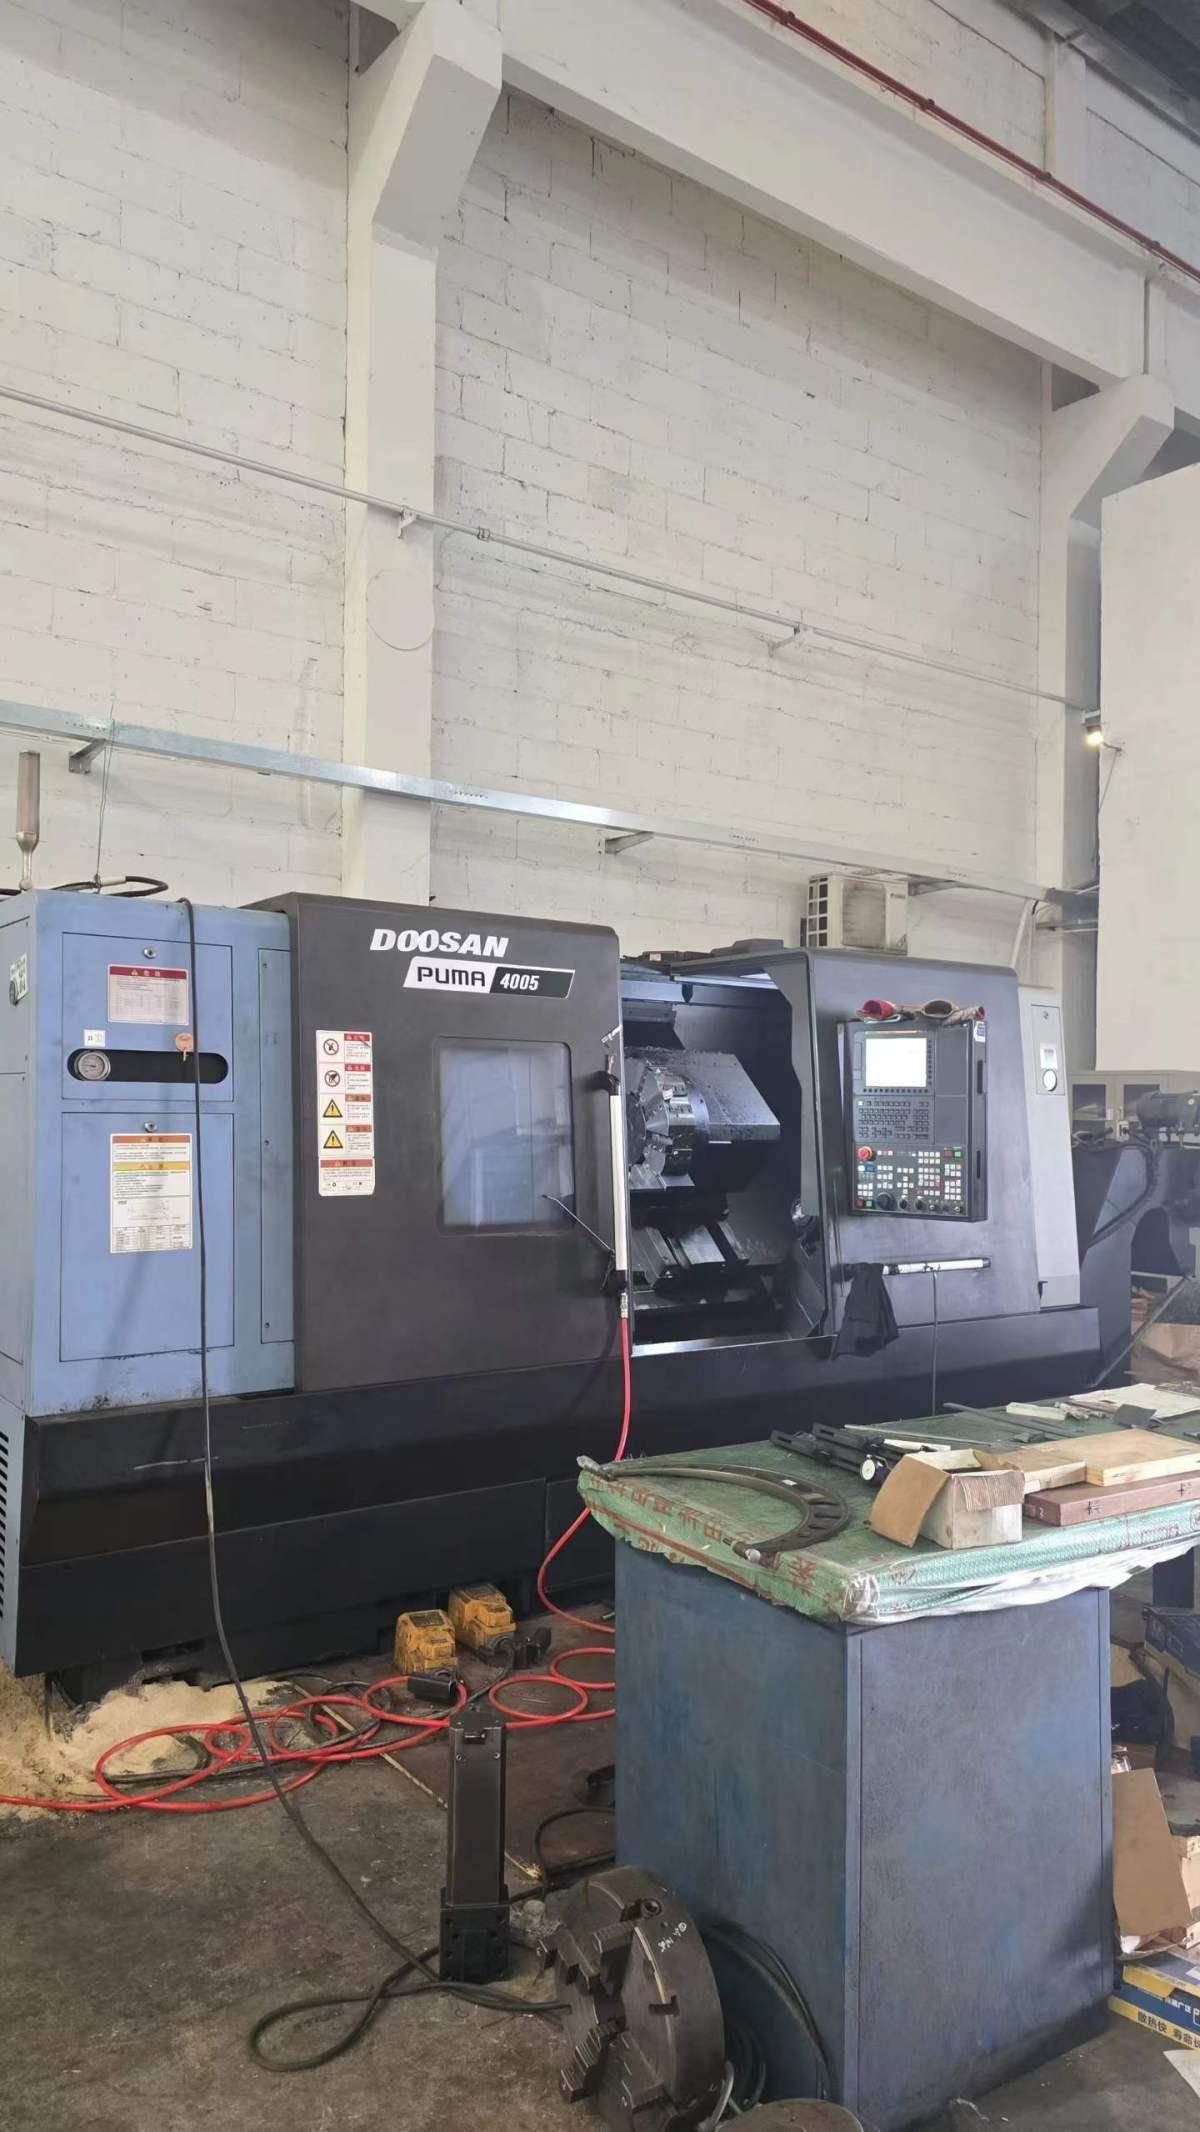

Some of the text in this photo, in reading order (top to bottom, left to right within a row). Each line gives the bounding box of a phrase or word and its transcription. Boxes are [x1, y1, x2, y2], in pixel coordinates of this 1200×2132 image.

[370, 928, 509, 957] DOOSAN
[417, 966, 540, 991] PUMA 4005
